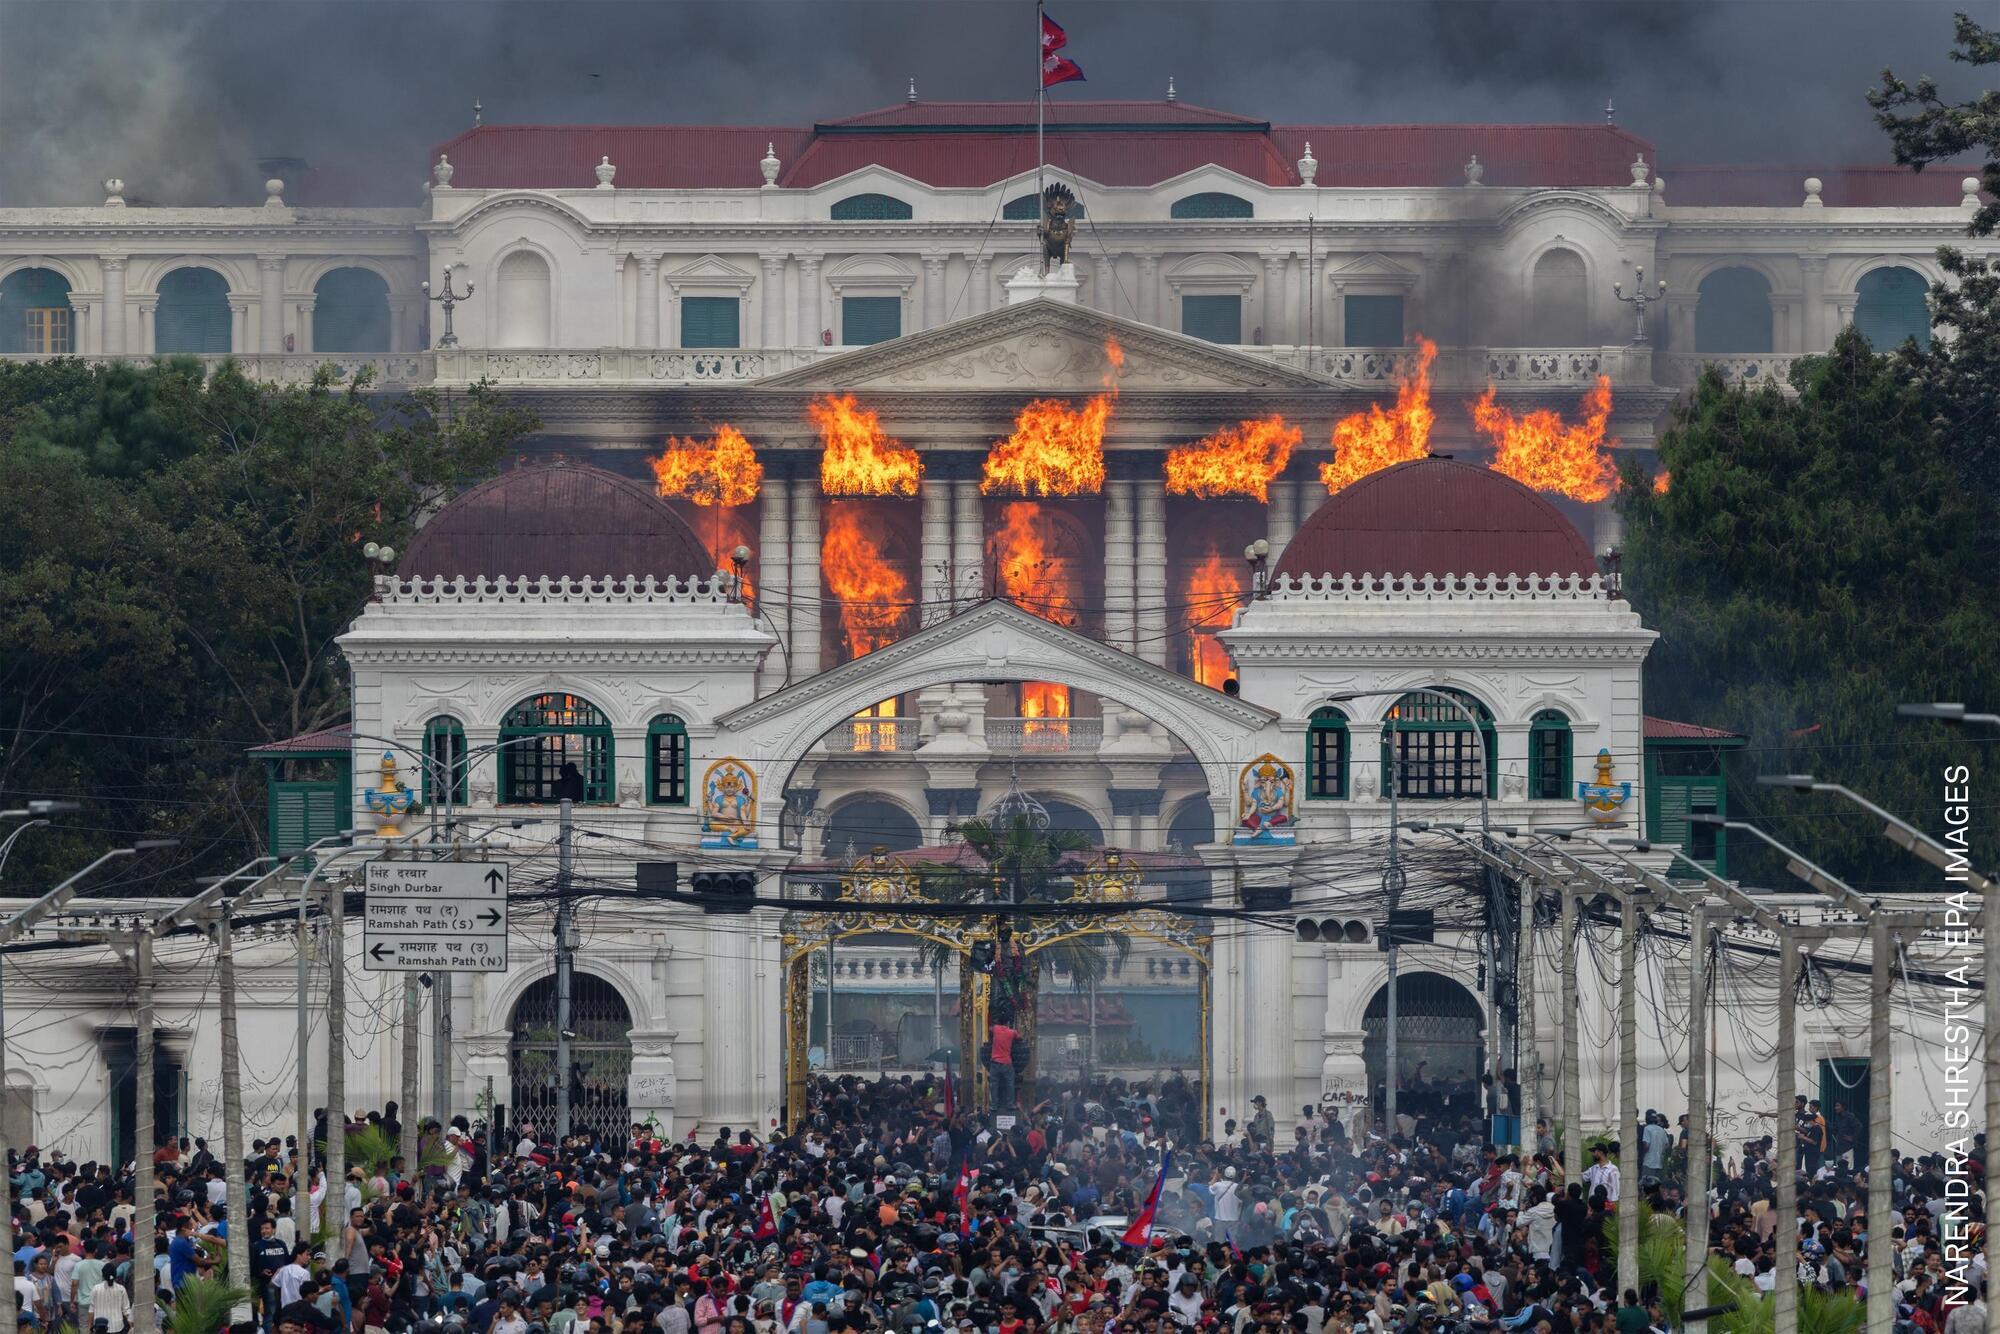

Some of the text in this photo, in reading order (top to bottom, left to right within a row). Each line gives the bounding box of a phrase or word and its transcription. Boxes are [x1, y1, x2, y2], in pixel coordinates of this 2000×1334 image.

[370, 866, 428, 879] सिंह दरबार
[369, 883, 443, 893] Singh Durbar
[369, 905, 459, 917] रामशाह पथ (द)
[368, 919, 474, 930] Ramshah Path (S)
[399, 942, 489, 955] रामशाह पथ (उ)
[398, 956, 503, 967] Ramshah Path (N)
